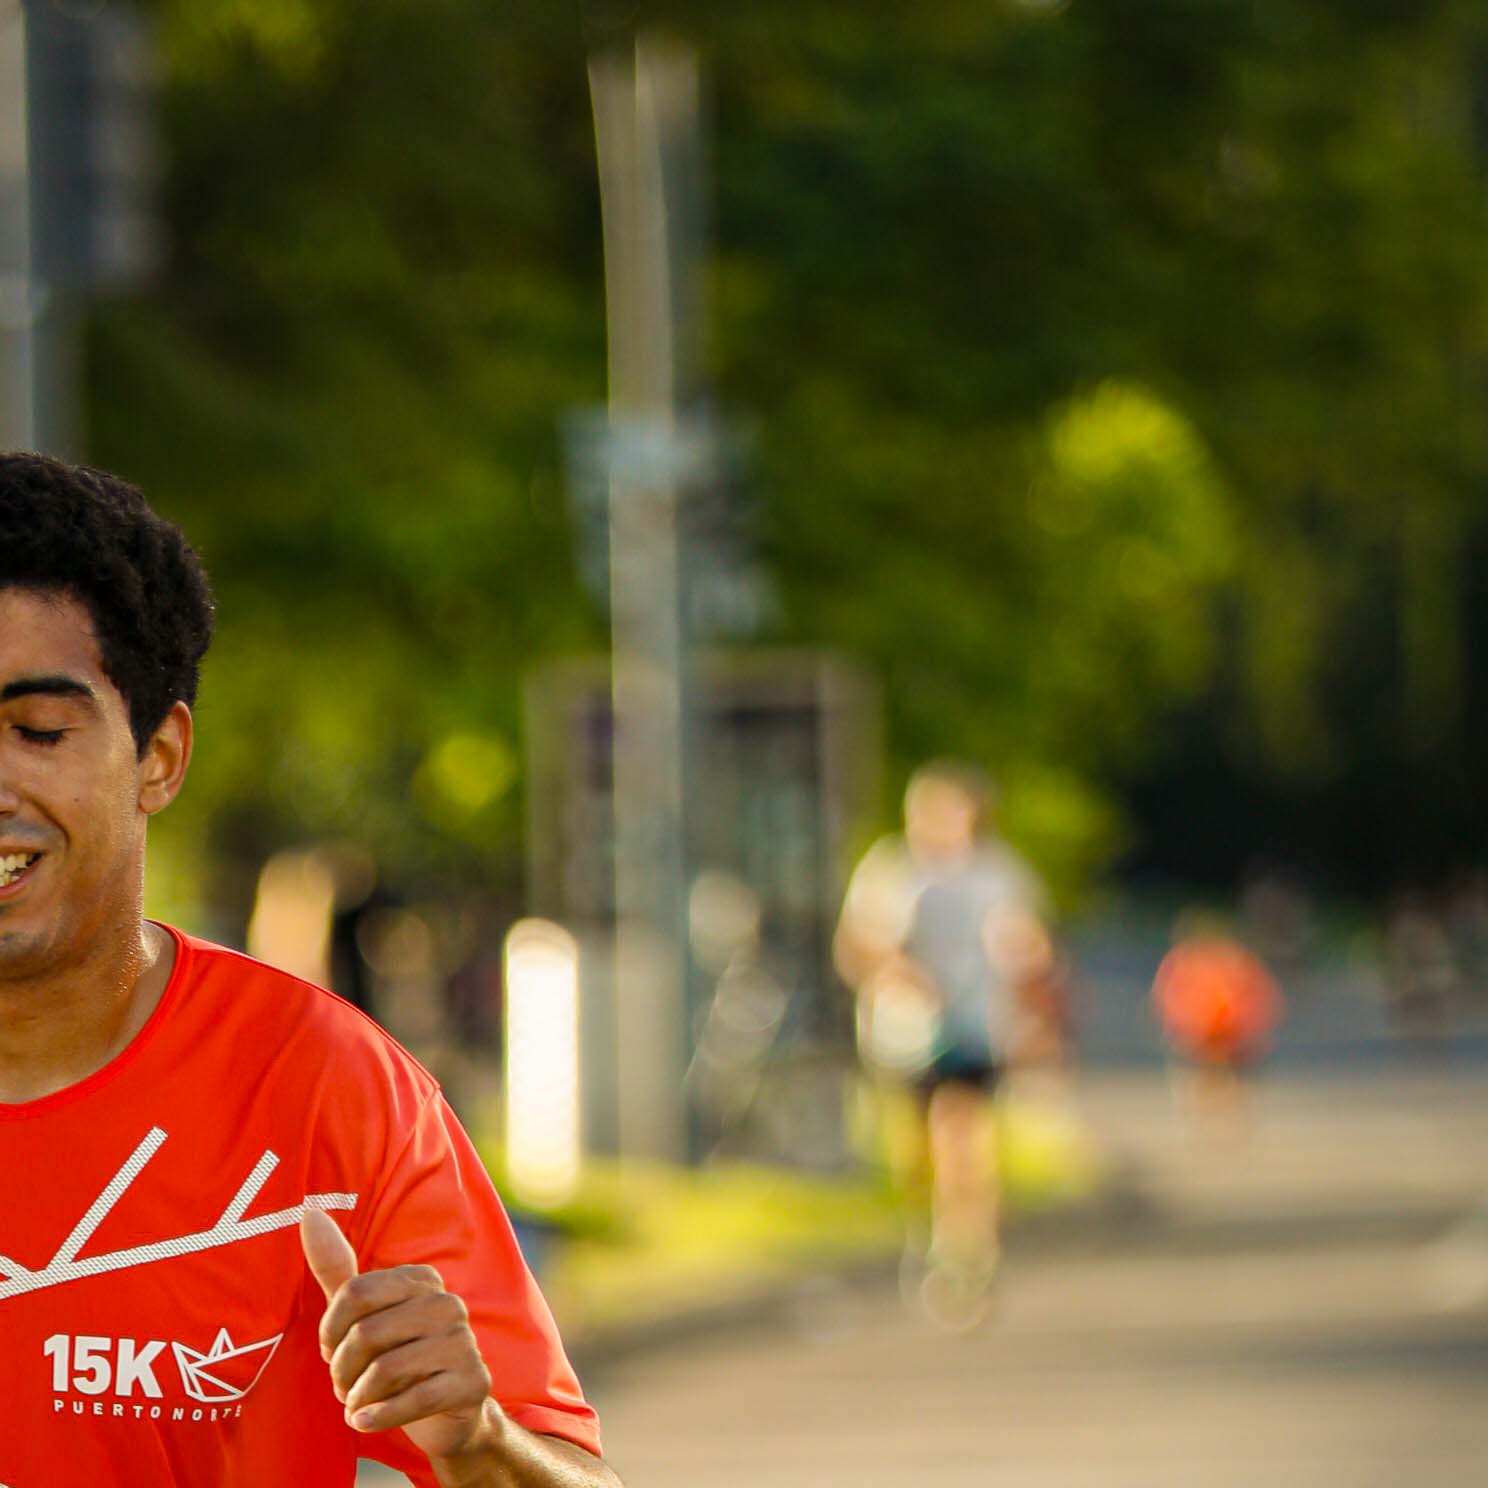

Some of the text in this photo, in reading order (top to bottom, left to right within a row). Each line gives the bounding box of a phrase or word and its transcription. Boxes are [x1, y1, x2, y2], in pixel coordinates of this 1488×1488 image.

[44, 1334, 167, 1398] 15K
[54, 1400, 242, 1421] PUERTO NORTE
